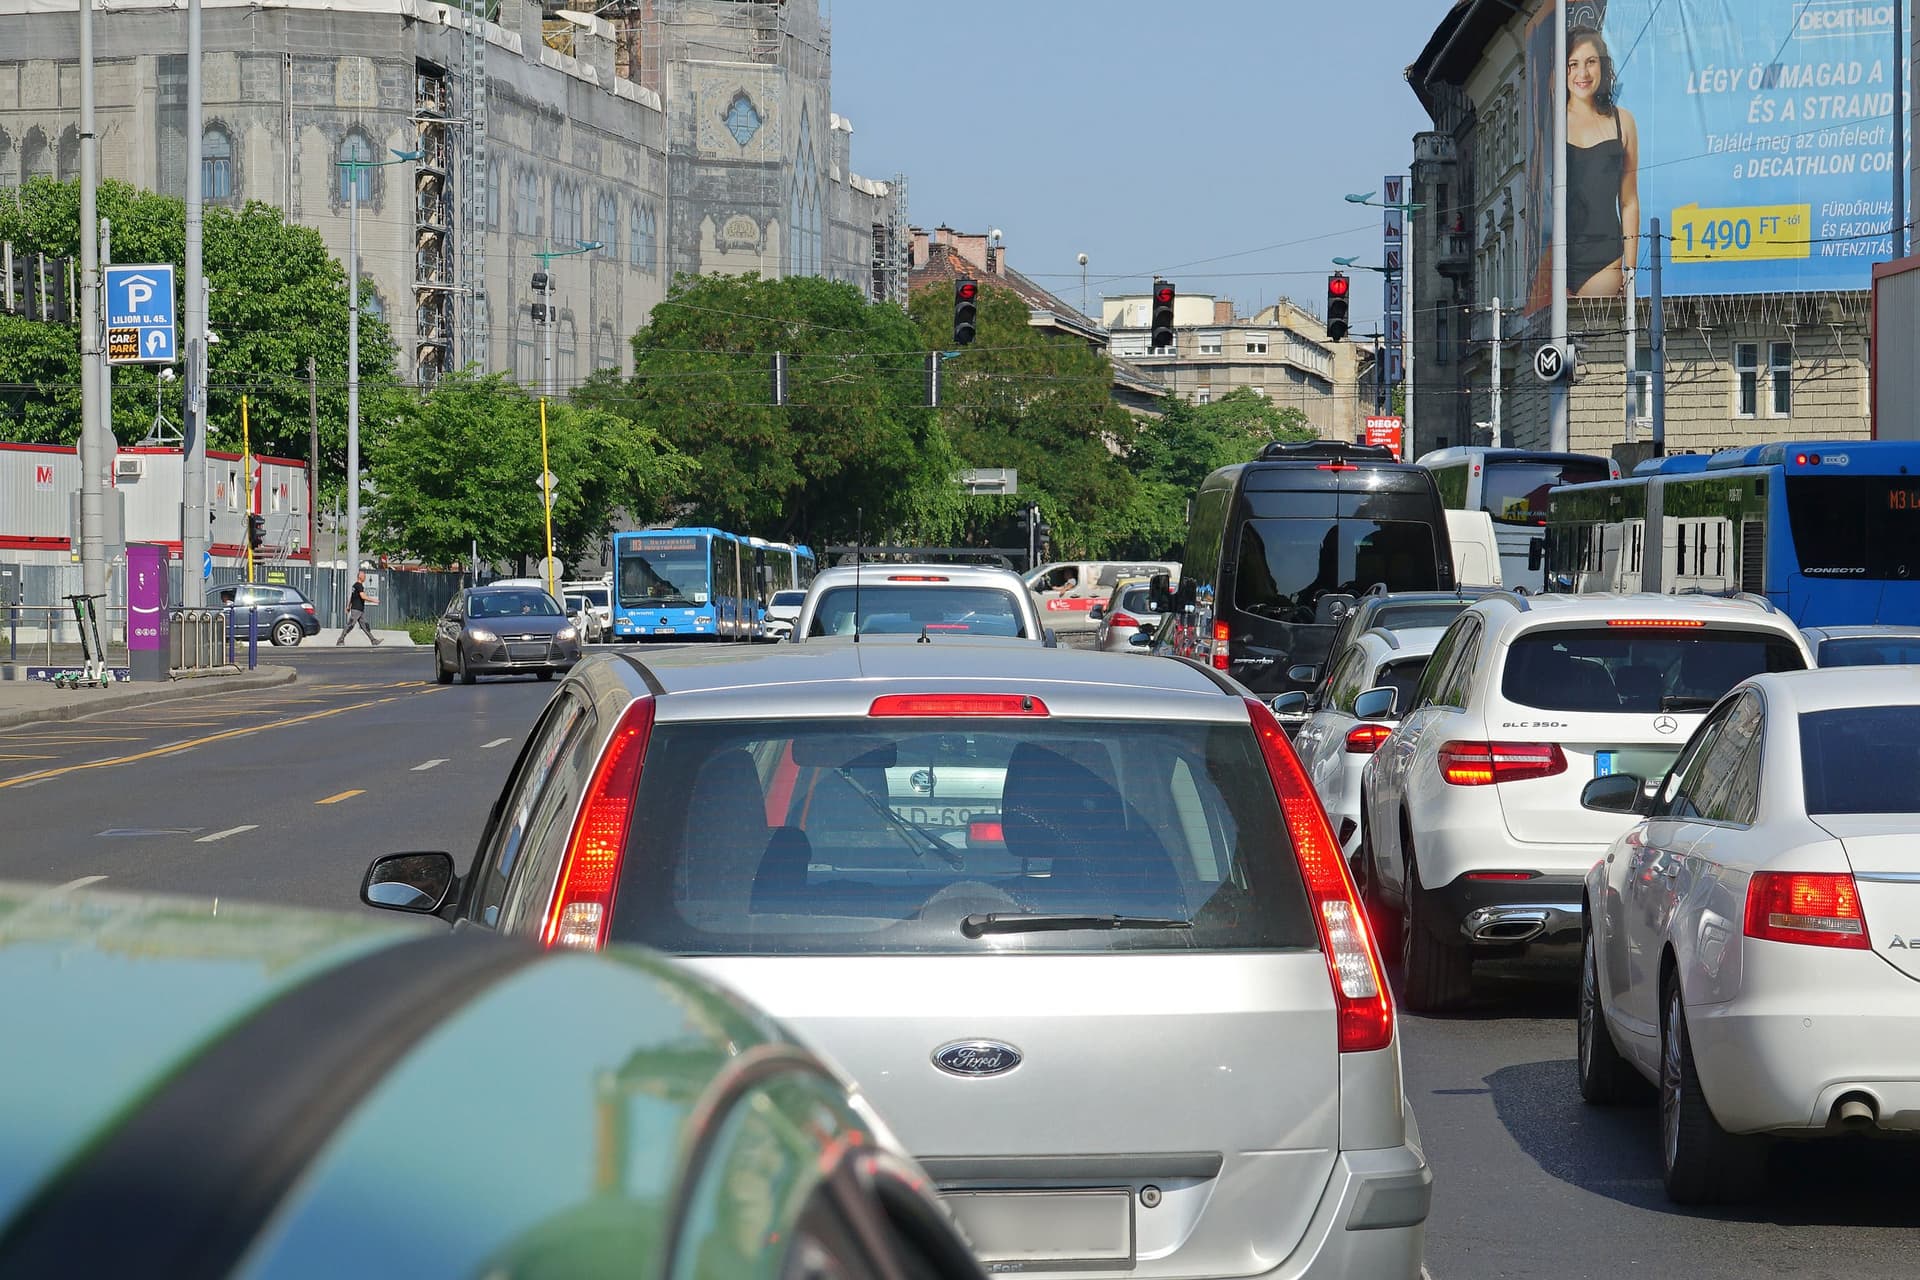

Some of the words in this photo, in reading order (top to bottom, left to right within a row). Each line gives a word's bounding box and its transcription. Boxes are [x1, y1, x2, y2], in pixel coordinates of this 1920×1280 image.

[1687, 64, 1743, 94] LÉGY
[1748, 62, 1863, 90] ÖNMAGAD
[1867, 59, 1883, 84] A
[1747, 96, 1776, 124] ÉS
[1779, 98, 1796, 122] A
[1706, 133, 1752, 153] Találd
[1757, 134, 1791, 153] meg
[1796, 134, 1813, 149] az
[1818, 125, 1885, 149] önfeledt
[1733, 163, 1743, 179] a
[1747, 153, 1856, 178] DECATHLON
[1760, 216, 1781, 235] FT
[1822, 222, 1836, 238] ÉS
[112, 315, 141, 324] LILIOM
[153, 314, 167, 323] 45.
[110, 344, 137, 353] PARK
[1367, 419, 1400, 428] DIEGO
[1890, 490, 1906, 509] M3
[1910, 492, 1920, 509] L
[948, 1047, 1002, 1068] Ford
